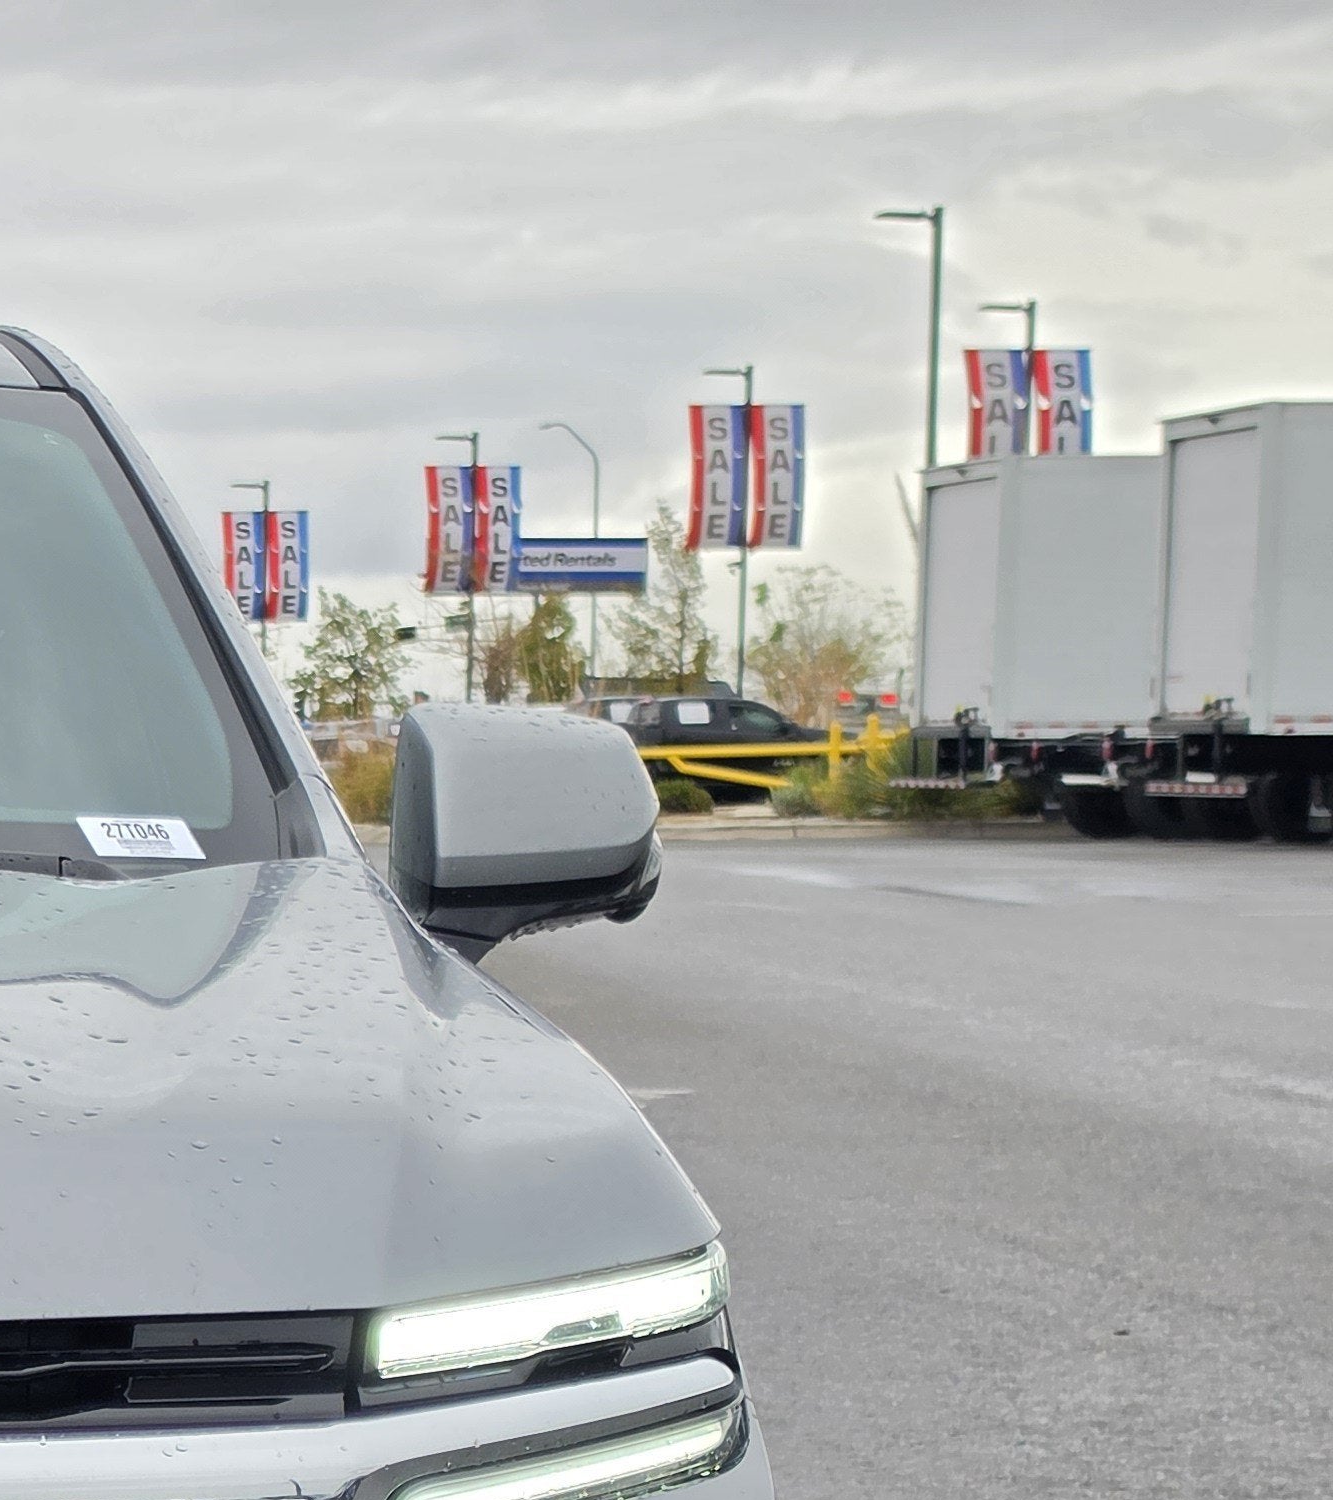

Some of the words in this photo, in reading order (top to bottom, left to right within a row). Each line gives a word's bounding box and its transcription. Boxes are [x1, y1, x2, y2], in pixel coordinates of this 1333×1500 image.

[707, 417, 729, 539] SALE
[768, 417, 791, 539] SALE
[235, 521, 253, 615] SALE
[280, 520, 298, 614] SALE
[441, 477, 462, 582] SALE
[490, 477, 510, 582] SALE
[519, 552, 551, 567] ted
[553, 552, 617, 567] Rentals
[101, 822, 170, 840] 27T046
